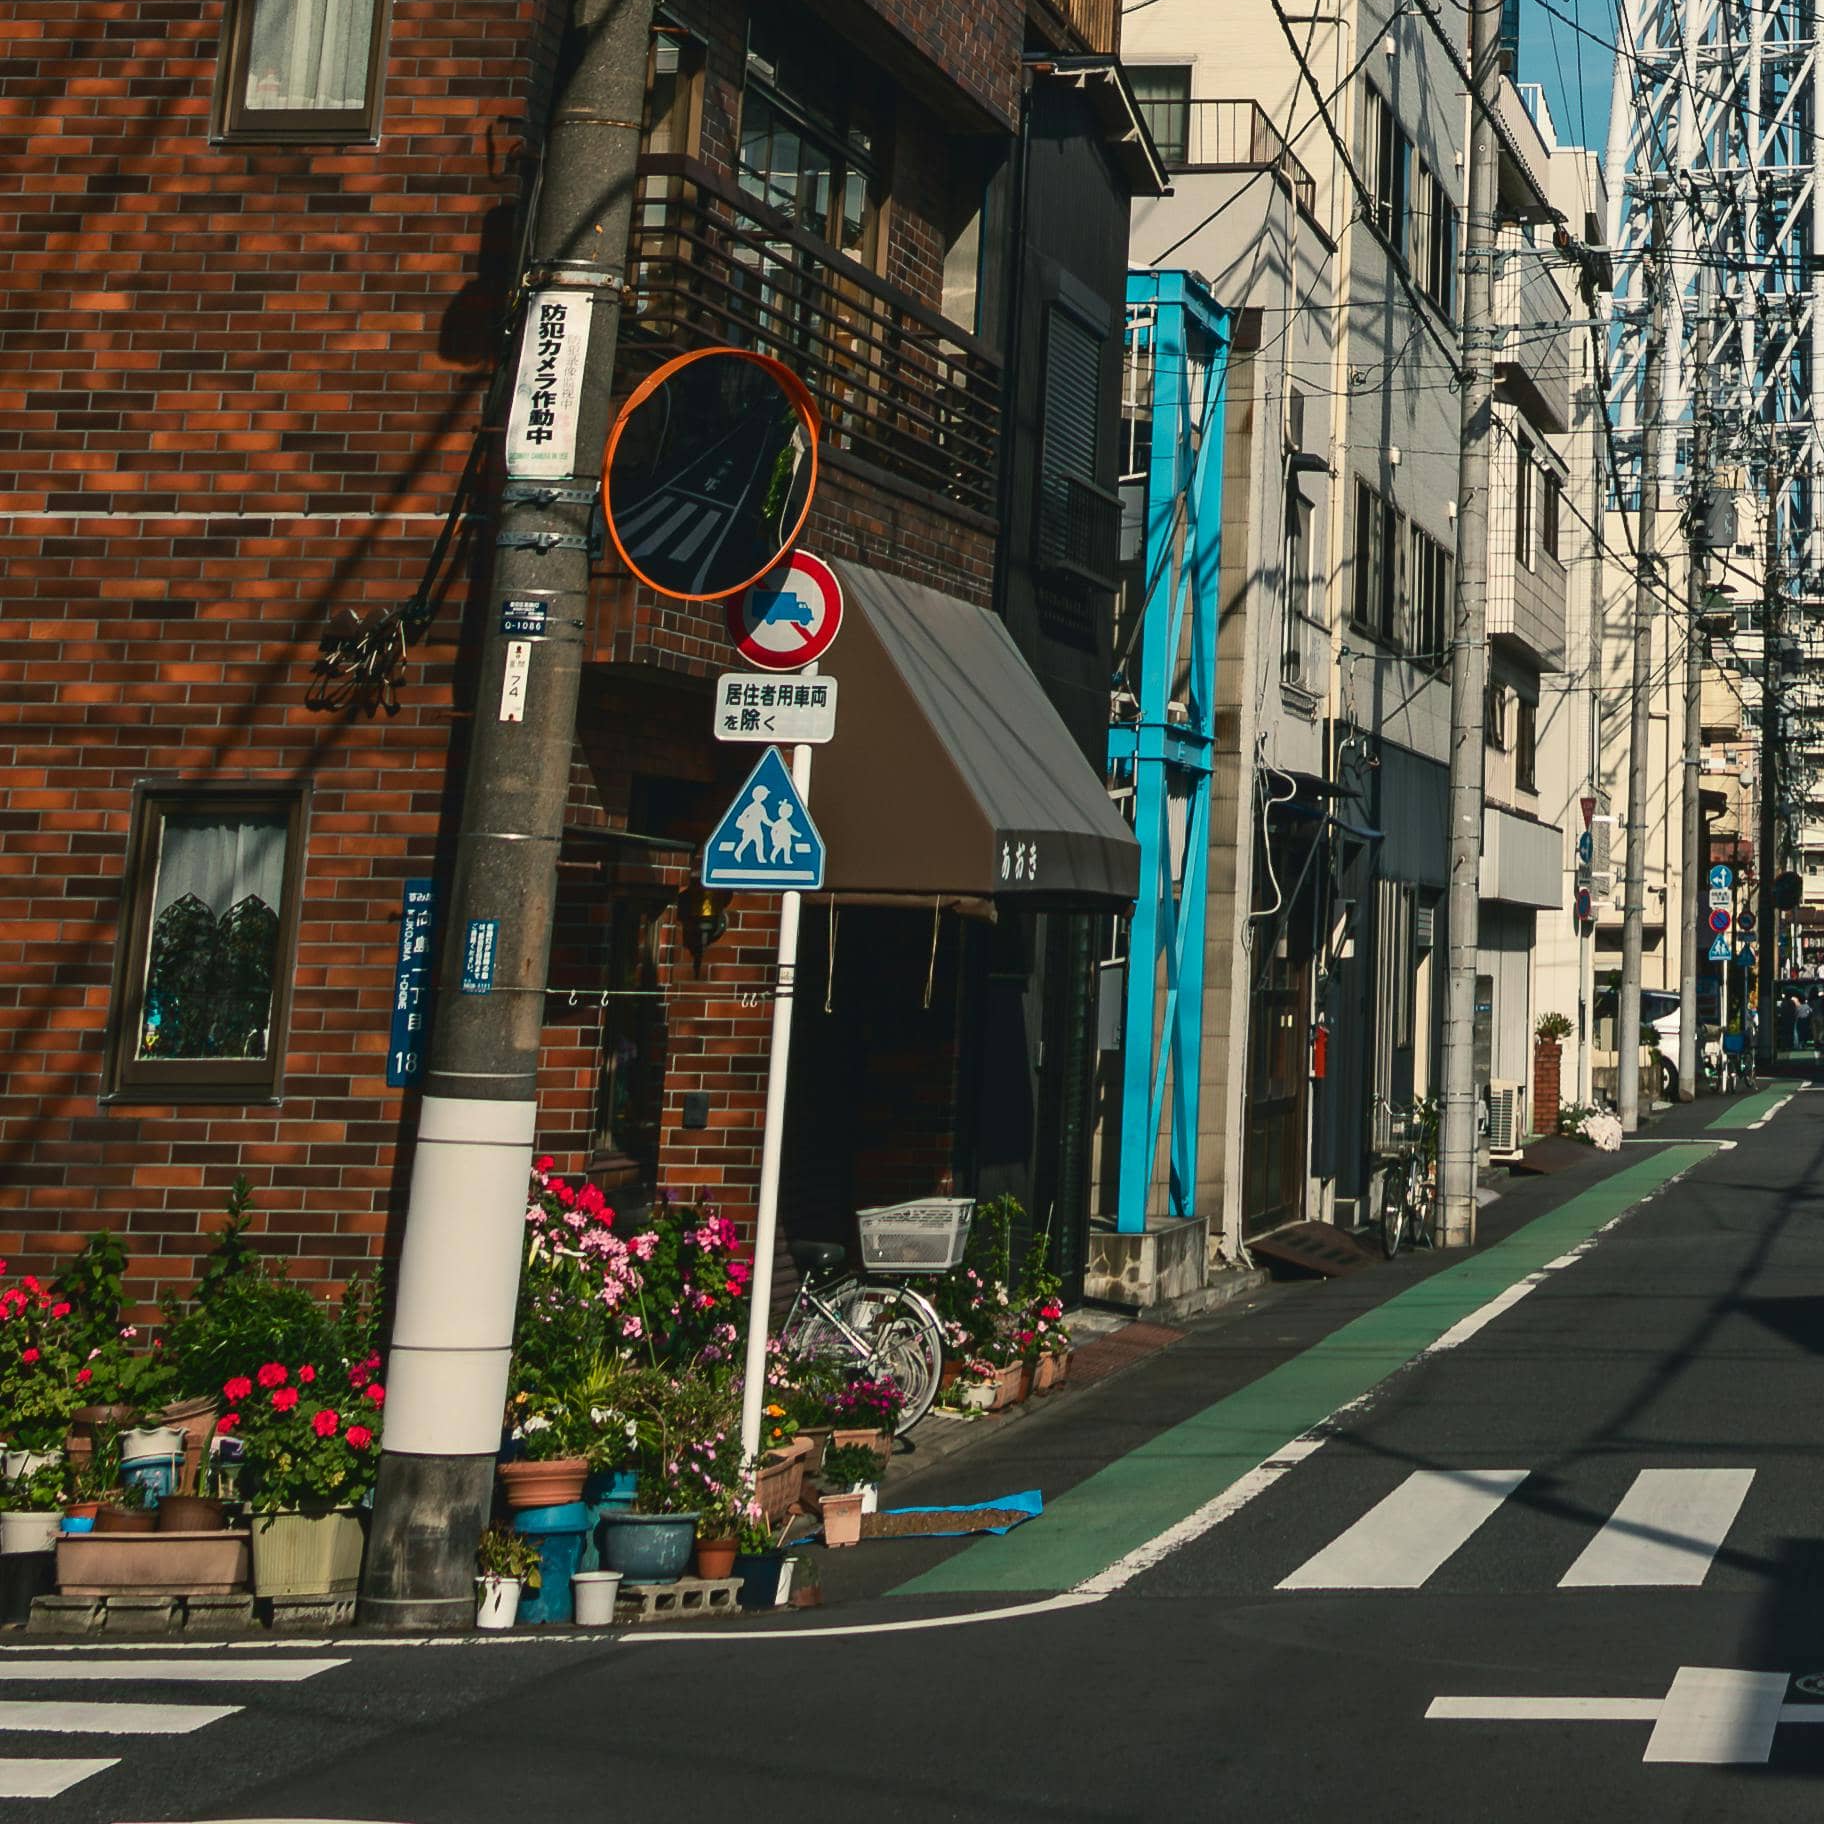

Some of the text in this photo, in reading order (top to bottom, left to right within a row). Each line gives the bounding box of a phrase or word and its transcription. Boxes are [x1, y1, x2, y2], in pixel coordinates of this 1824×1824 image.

[526, 304, 567, 445] 防犯カメラ作動中
[725, 683, 828, 707] 居住者用車両
[724, 709, 776, 731] を除く
[395, 1052, 417, 1074] 18
